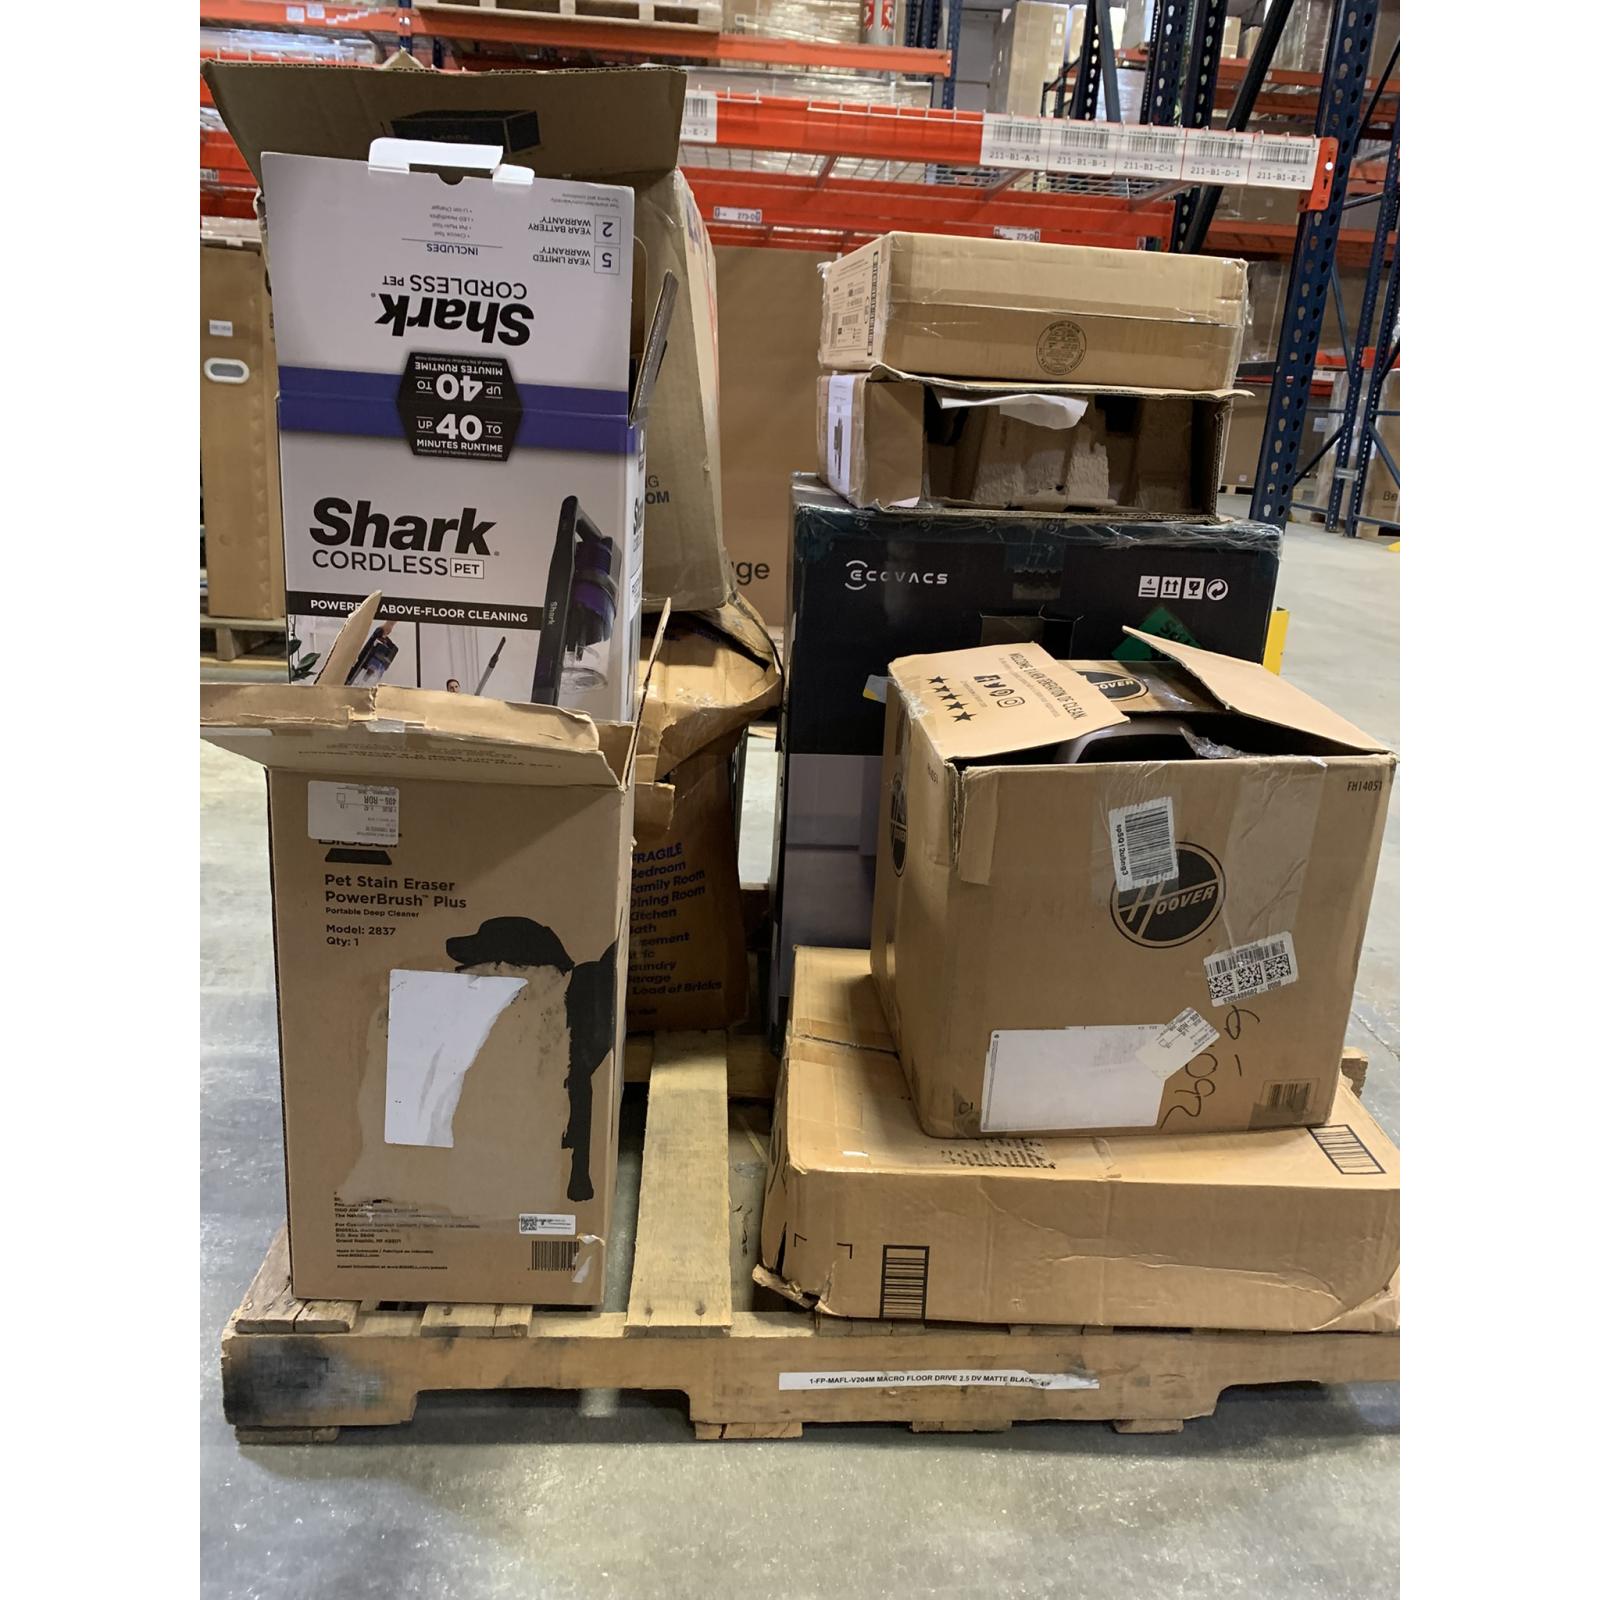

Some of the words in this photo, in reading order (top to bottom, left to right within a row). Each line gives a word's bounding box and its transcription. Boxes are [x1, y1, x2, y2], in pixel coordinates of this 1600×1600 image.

[528, 222, 566, 233] BATTERY
[568, 228, 591, 236] YEAR
[602, 221, 613, 238] 2
[426, 243, 479, 255] INCLUDES
[532, 254, 566, 264] LIMITED
[567, 258, 590, 266] YEAR
[602, 252, 612, 268] 5
[382, 275, 405, 286] PET
[409, 274, 528, 300] CORDLESS
[374, 293, 535, 346] Shark
[415, 361, 458, 371] RUNTIME
[461, 365, 503, 376] MINUTES
[417, 381, 433, 391] TO
[436, 373, 483, 402] 40
[486, 387, 502, 396] UP
[417, 420, 433, 429] UP
[435, 413, 483, 441] 40
[486, 424, 502, 435] TO
[416, 438, 459, 450] MINUTES
[460, 441, 503, 453] RUNTIME
[309, 497, 497, 556] Shark
[312, 549, 448, 577] CORDLESS
[454, 562, 480, 575] PET
[731, 561, 770, 586] ge
[845, 560, 948, 590] ECOVACS
[310, 599, 362, 612] POWERE
[380, 604, 465, 619] ABOVE-FLOOR
[467, 609, 528, 623] CLEANING
[1099, 680, 1135, 690] OVER
[325, 874, 351, 887] Pet
[357, 876, 398, 889] Stain
[404, 878, 455, 891] Eraser
[673, 870, 706, 886] Room
[672, 886, 706, 901] Room
[433, 896, 467, 908] Plus
[325, 907, 361, 915] Portable
[363, 909, 385, 917] Deep
[326, 924, 364, 935] Model:
[368, 926, 396, 936] 2837
[326, 937, 351, 947] Qty:
[354, 938, 359, 946] 1
[809, 1376, 875, 1384] 1-FP-MAFL-V204M
